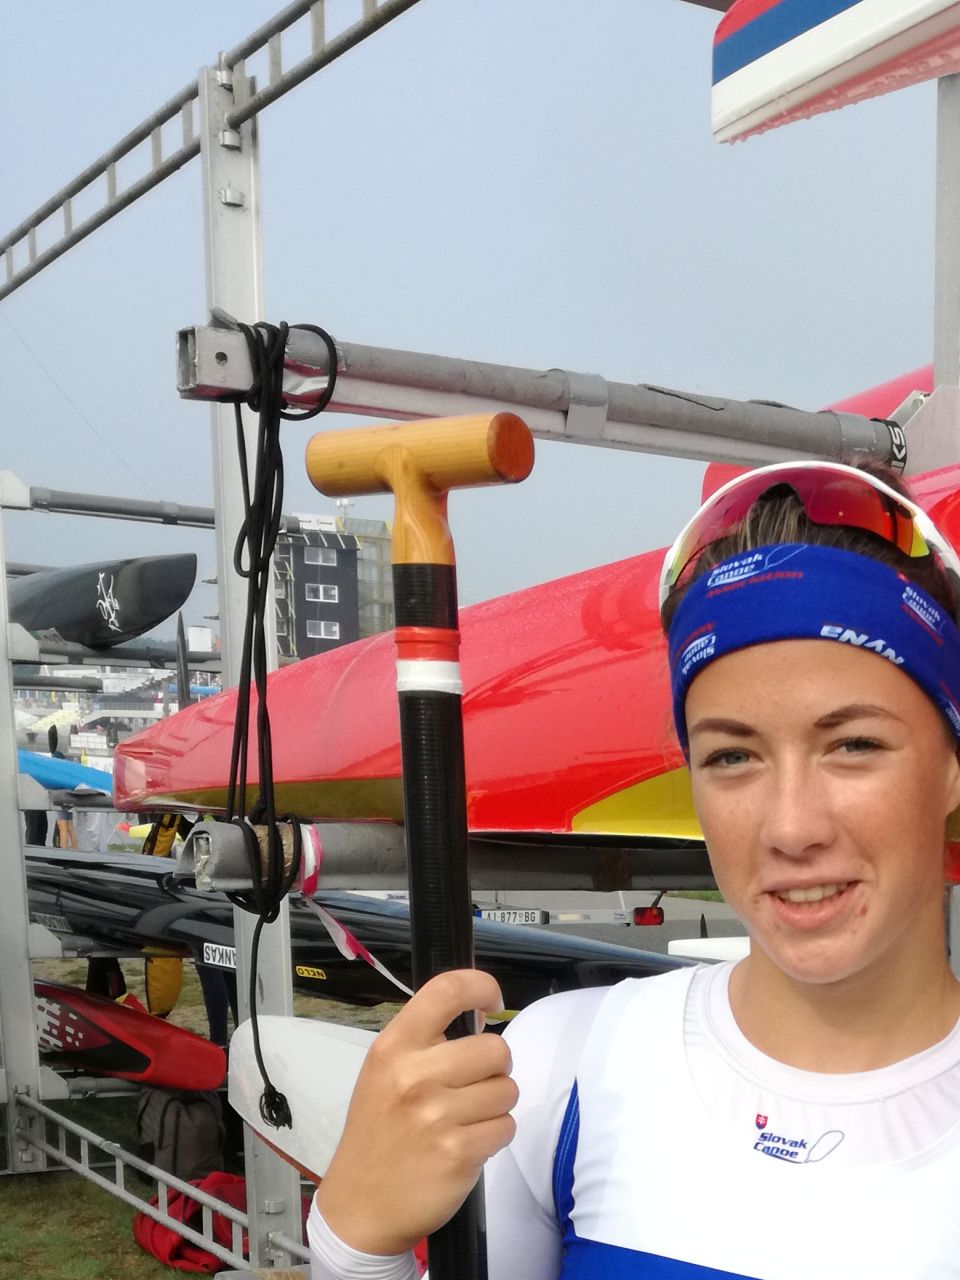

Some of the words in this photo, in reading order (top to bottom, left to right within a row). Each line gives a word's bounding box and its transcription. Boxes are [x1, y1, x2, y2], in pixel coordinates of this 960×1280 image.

[524, 911, 536, 922] BG
[758, 1132, 808, 1149] Slovak
[753, 1142, 799, 1159] Canoe
